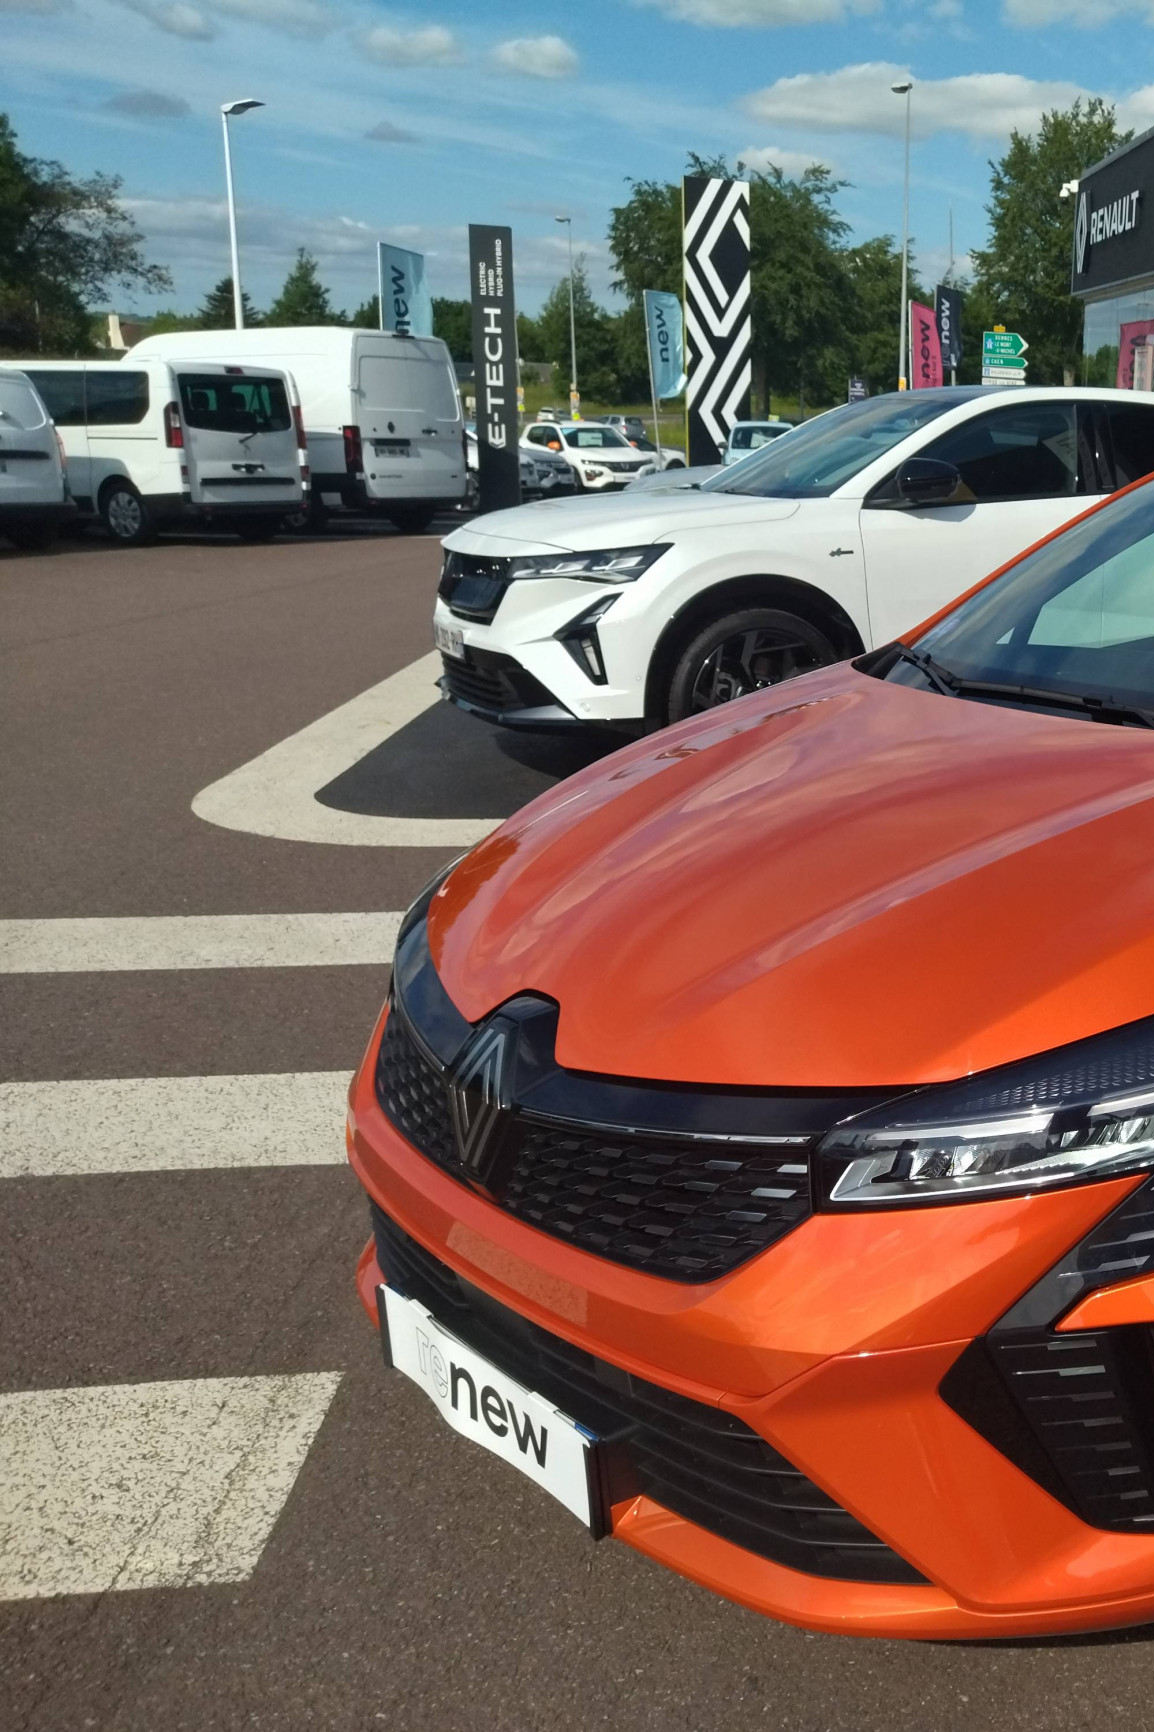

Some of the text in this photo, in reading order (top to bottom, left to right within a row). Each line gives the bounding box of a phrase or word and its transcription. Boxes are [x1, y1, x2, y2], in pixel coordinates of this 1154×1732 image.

[1090, 190, 1140, 246] RENAULT
[479, 262, 487, 296] ELECTRIC
[654, 305, 670, 363] new
[483, 307, 506, 450] E-TECH
[415, 1326, 549, 1469] renew
